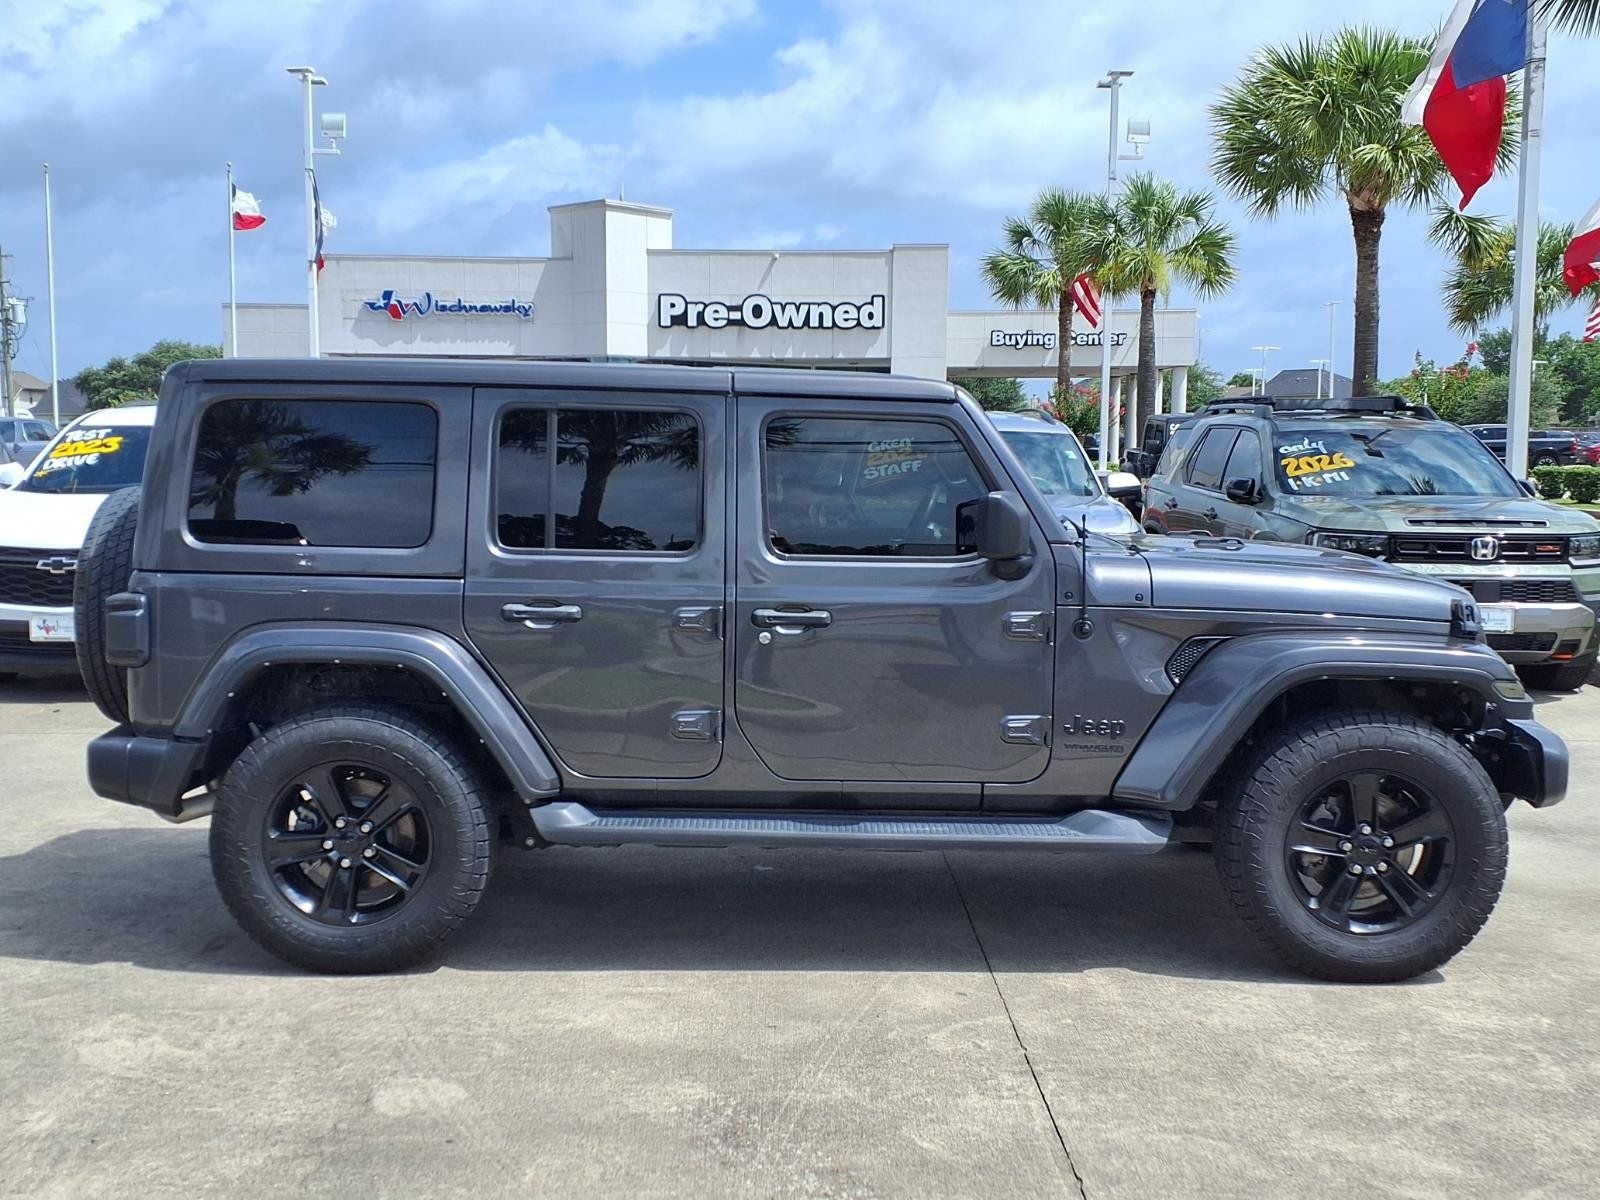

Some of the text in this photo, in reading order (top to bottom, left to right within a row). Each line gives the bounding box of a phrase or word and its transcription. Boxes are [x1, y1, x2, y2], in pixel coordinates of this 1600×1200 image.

[658, 293, 885, 329] Pre-Owned
[991, 330, 1056, 349] Buying
[65, 428, 113, 443] TEST
[867, 436, 916, 453] GREA
[42, 453, 101, 471] DRIVE
[863, 459, 923, 480] STAFF
[1281, 452, 1356, 478] 2026
[1063, 714, 1125, 740] Jeep
